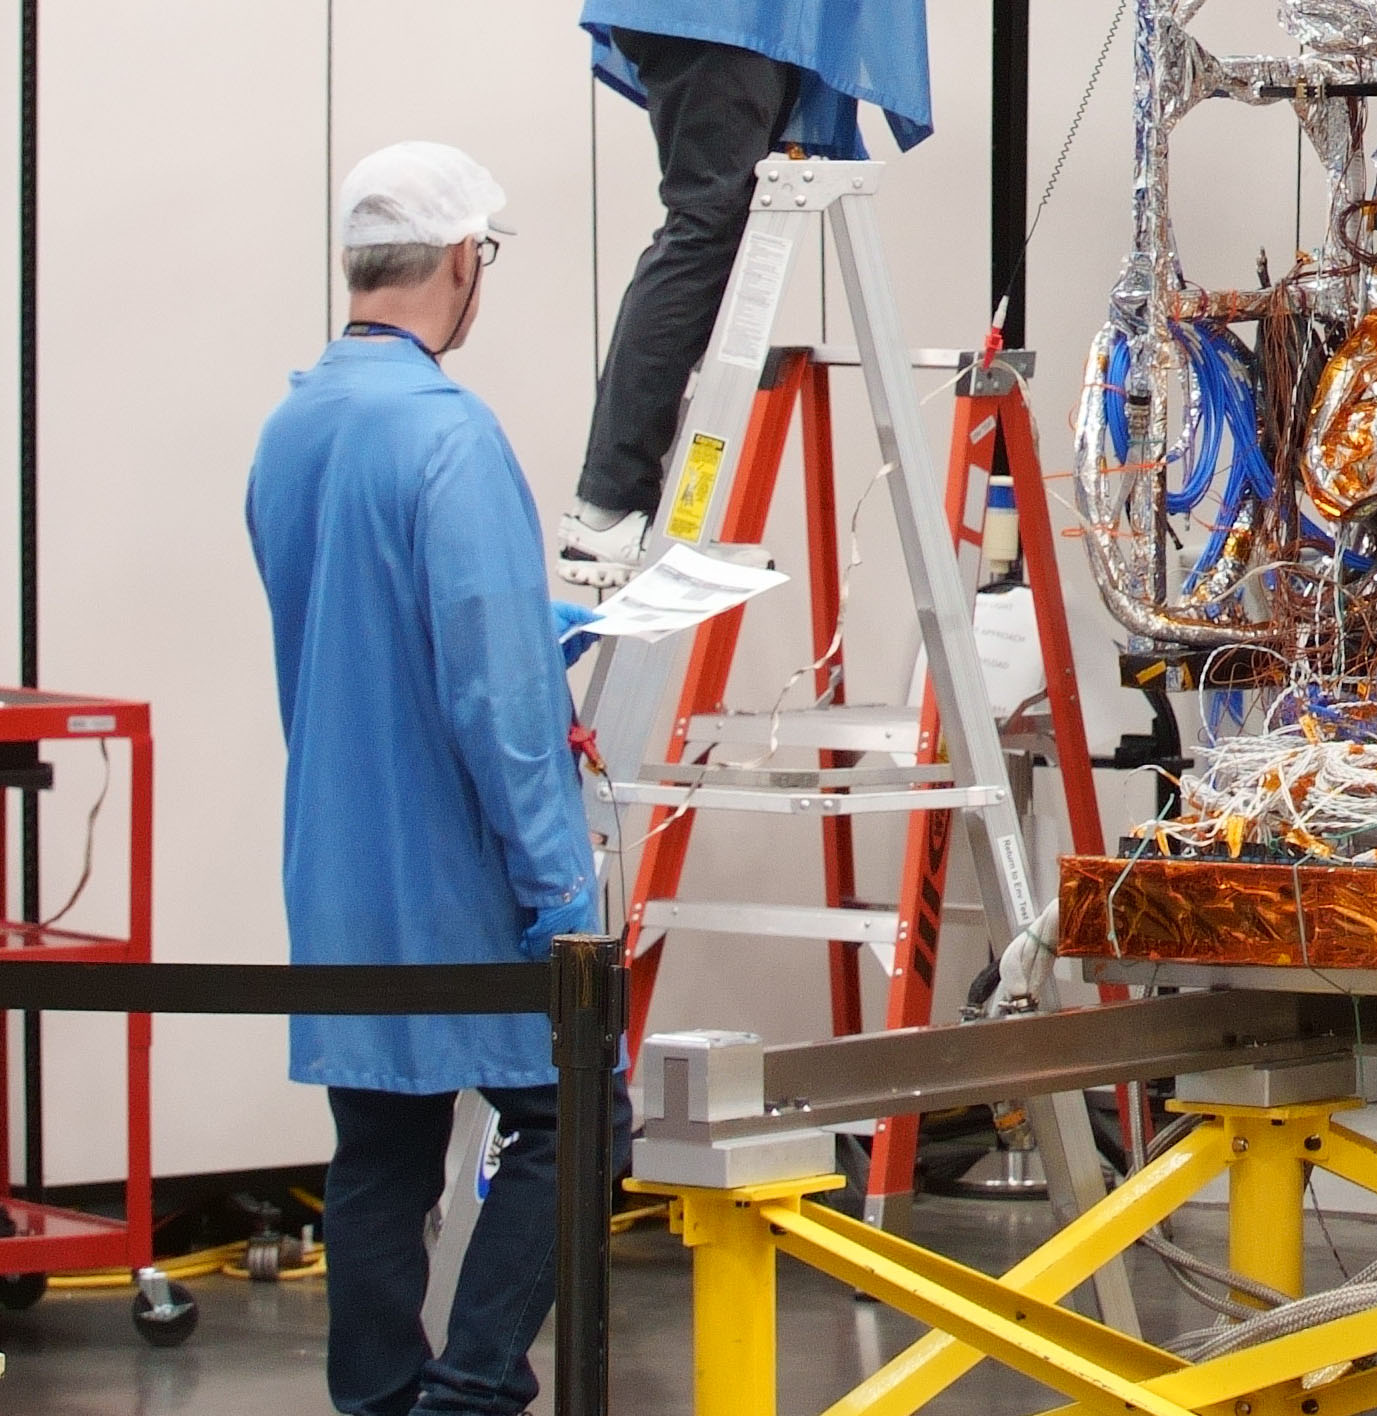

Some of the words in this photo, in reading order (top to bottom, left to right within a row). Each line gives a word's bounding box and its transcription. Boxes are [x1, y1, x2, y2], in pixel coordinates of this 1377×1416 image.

[1003, 839, 1016, 870] Return
[1011, 870, 1018, 880] to
[1013, 881, 1023, 899] Env
[1018, 901, 1030, 921] Test
